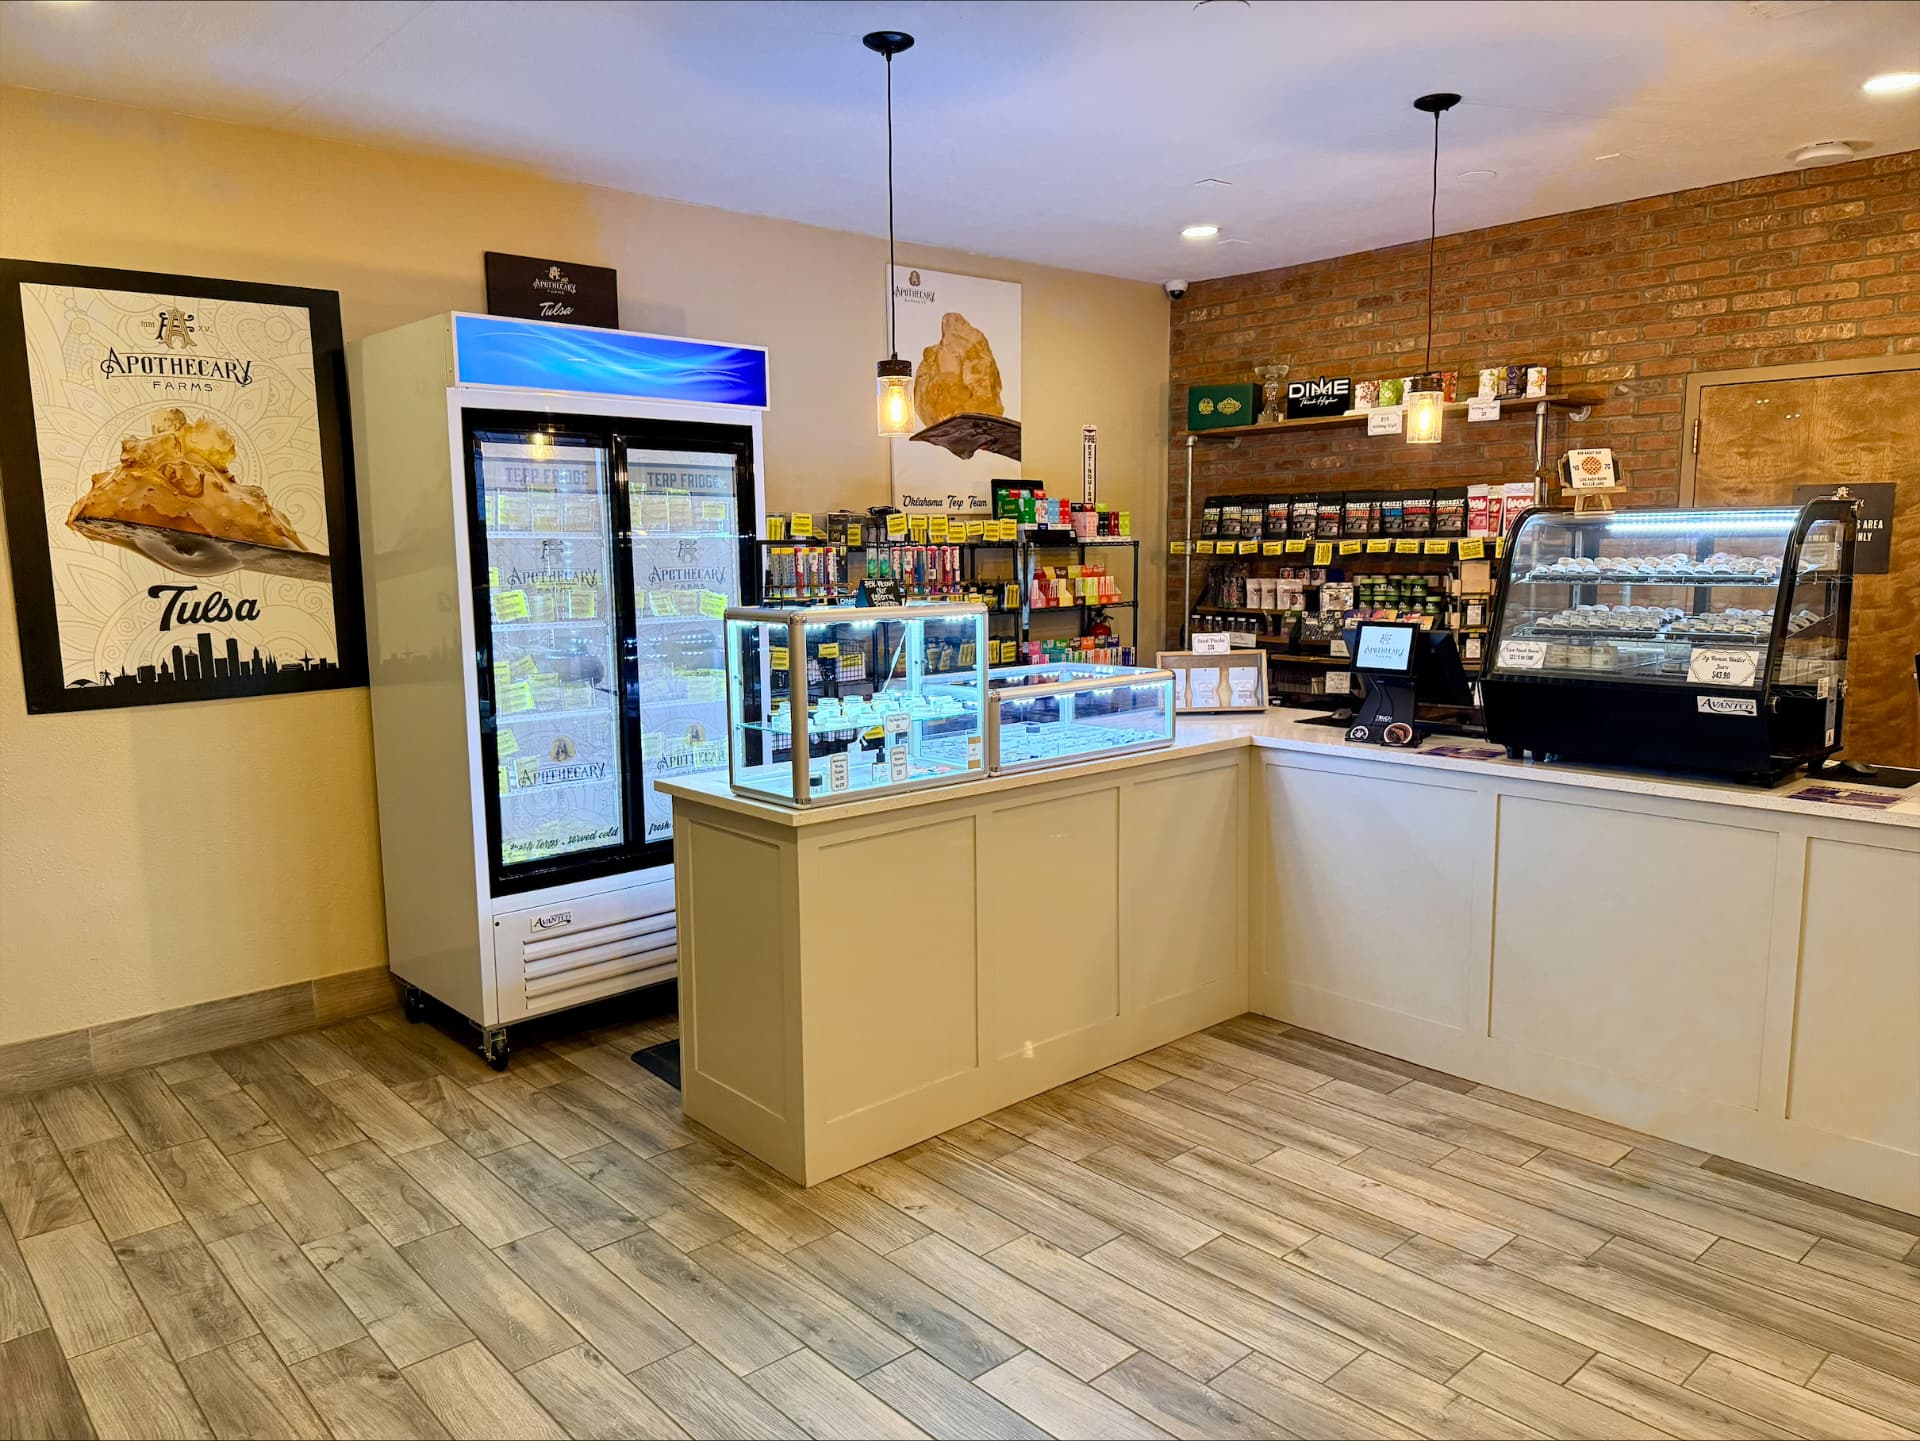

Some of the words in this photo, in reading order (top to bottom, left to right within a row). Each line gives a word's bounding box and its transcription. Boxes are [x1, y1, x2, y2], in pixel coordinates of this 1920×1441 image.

[532, 278, 577, 294] APOTHECARY
[539, 301, 575, 317] Tulsa
[100, 347, 253, 387] APOTHECARY
[152, 380, 213, 392] FARMS
[1289, 377, 1349, 398] DIME
[647, 471, 677, 489] TERP
[903, 495, 943, 507] Oklahoma
[968, 495, 988, 509] Team
[1403, 500, 1431, 508] GRIZZLY
[1863, 519, 1883, 529] AREA
[1856, 532, 1872, 541] NLY
[508, 567, 598, 588] APOTHECARY
[649, 564, 727, 585] APOTHECARY
[1701, 698, 1755, 714] AVANTCO
[518, 762, 605, 787] APOTHECARY
[598, 827, 619, 840] cold
